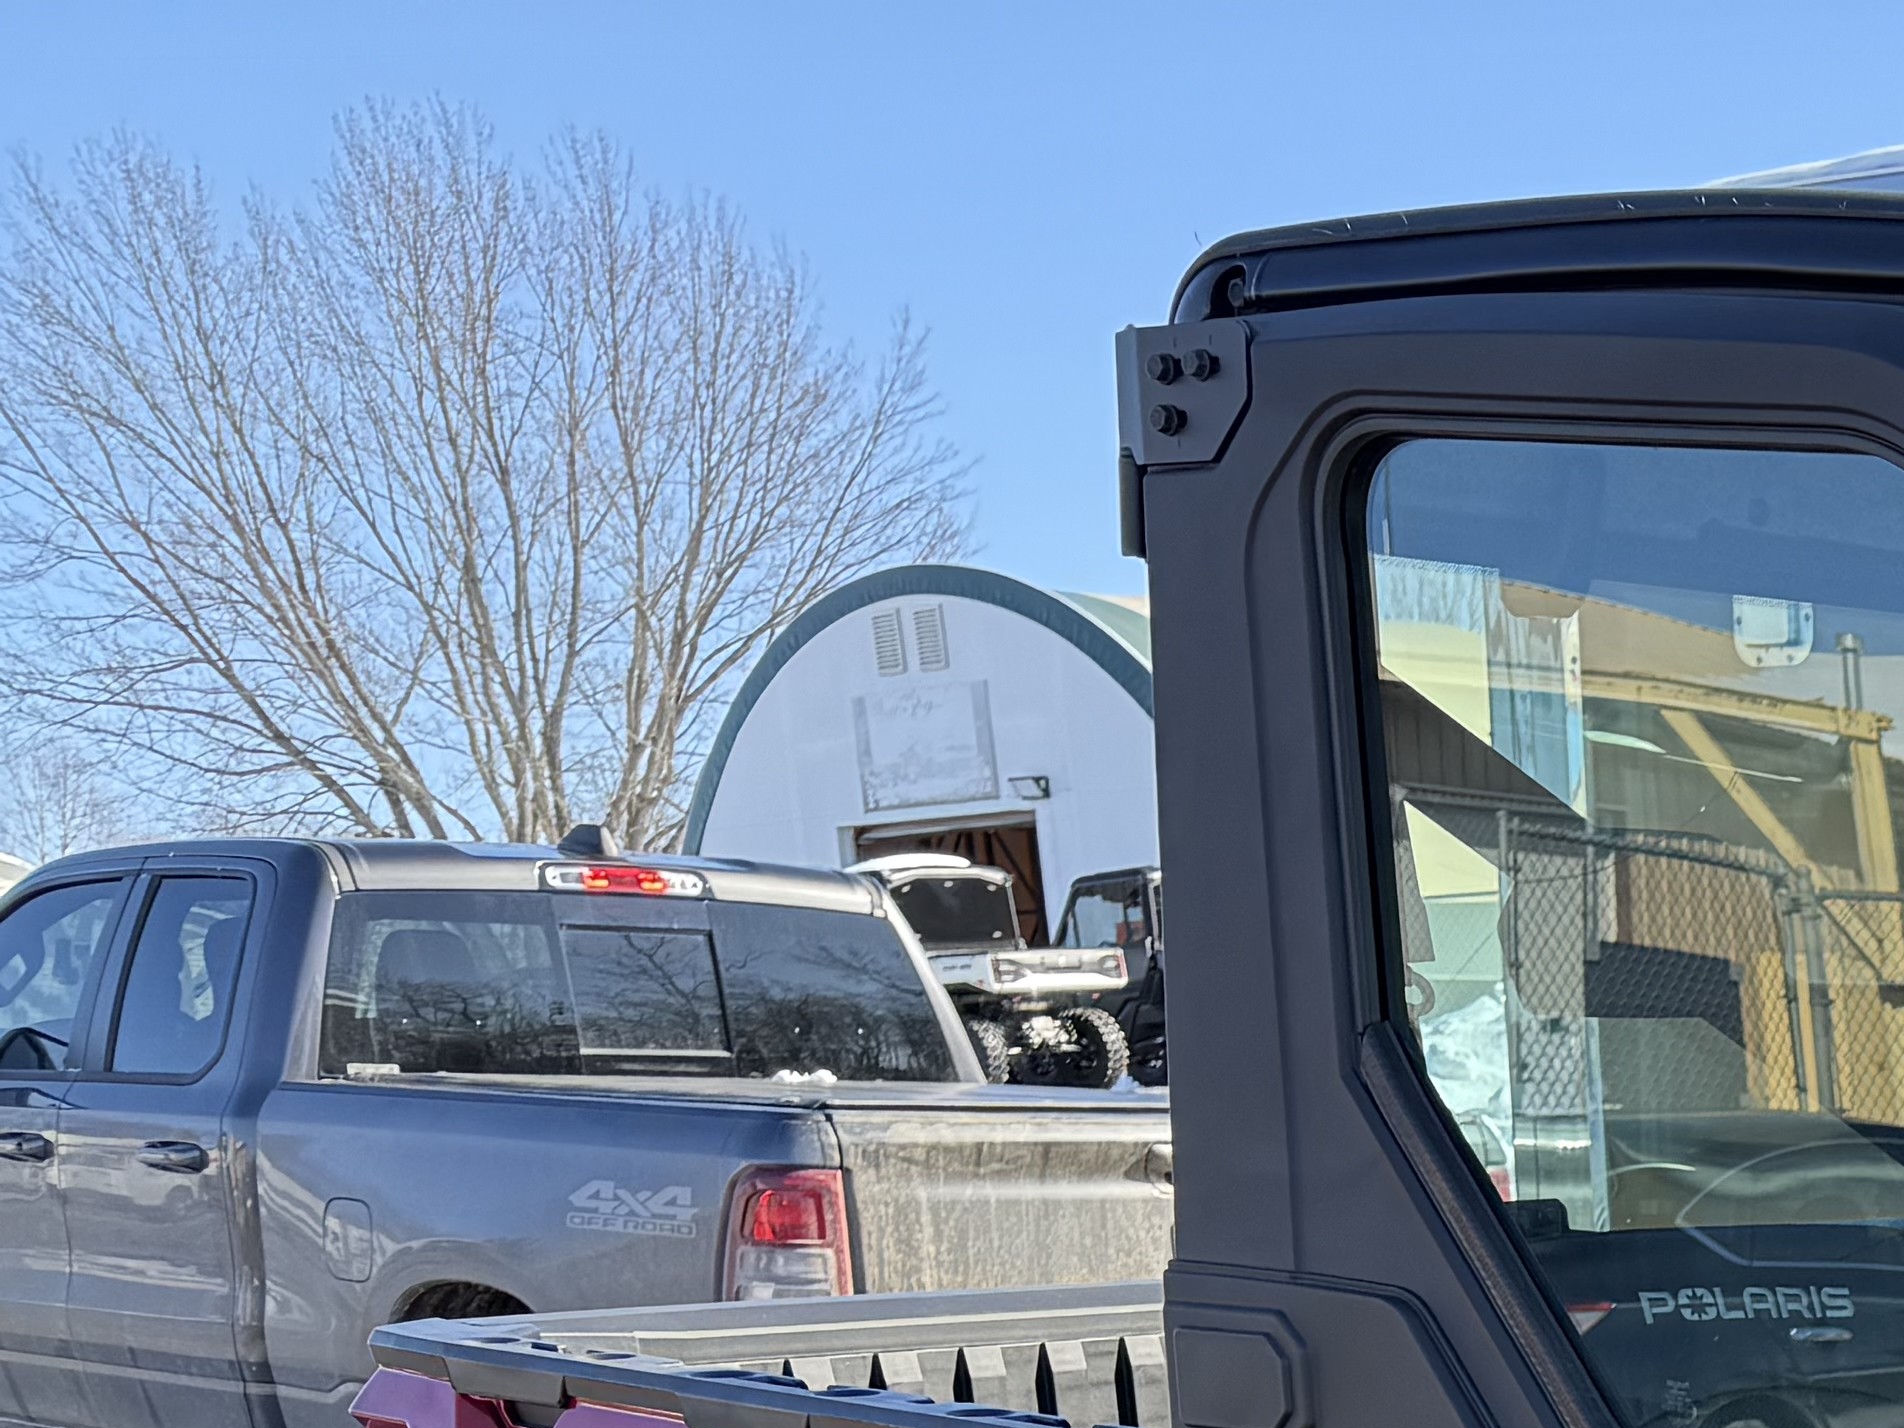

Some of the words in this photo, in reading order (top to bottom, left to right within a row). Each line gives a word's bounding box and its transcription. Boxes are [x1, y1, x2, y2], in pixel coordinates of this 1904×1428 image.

[567, 1179, 699, 1221] 4x4
[568, 1214, 619, 1228] OFF
[623, 1219, 694, 1236] ROAD
[1637, 1285, 1854, 1325] POLARIS
